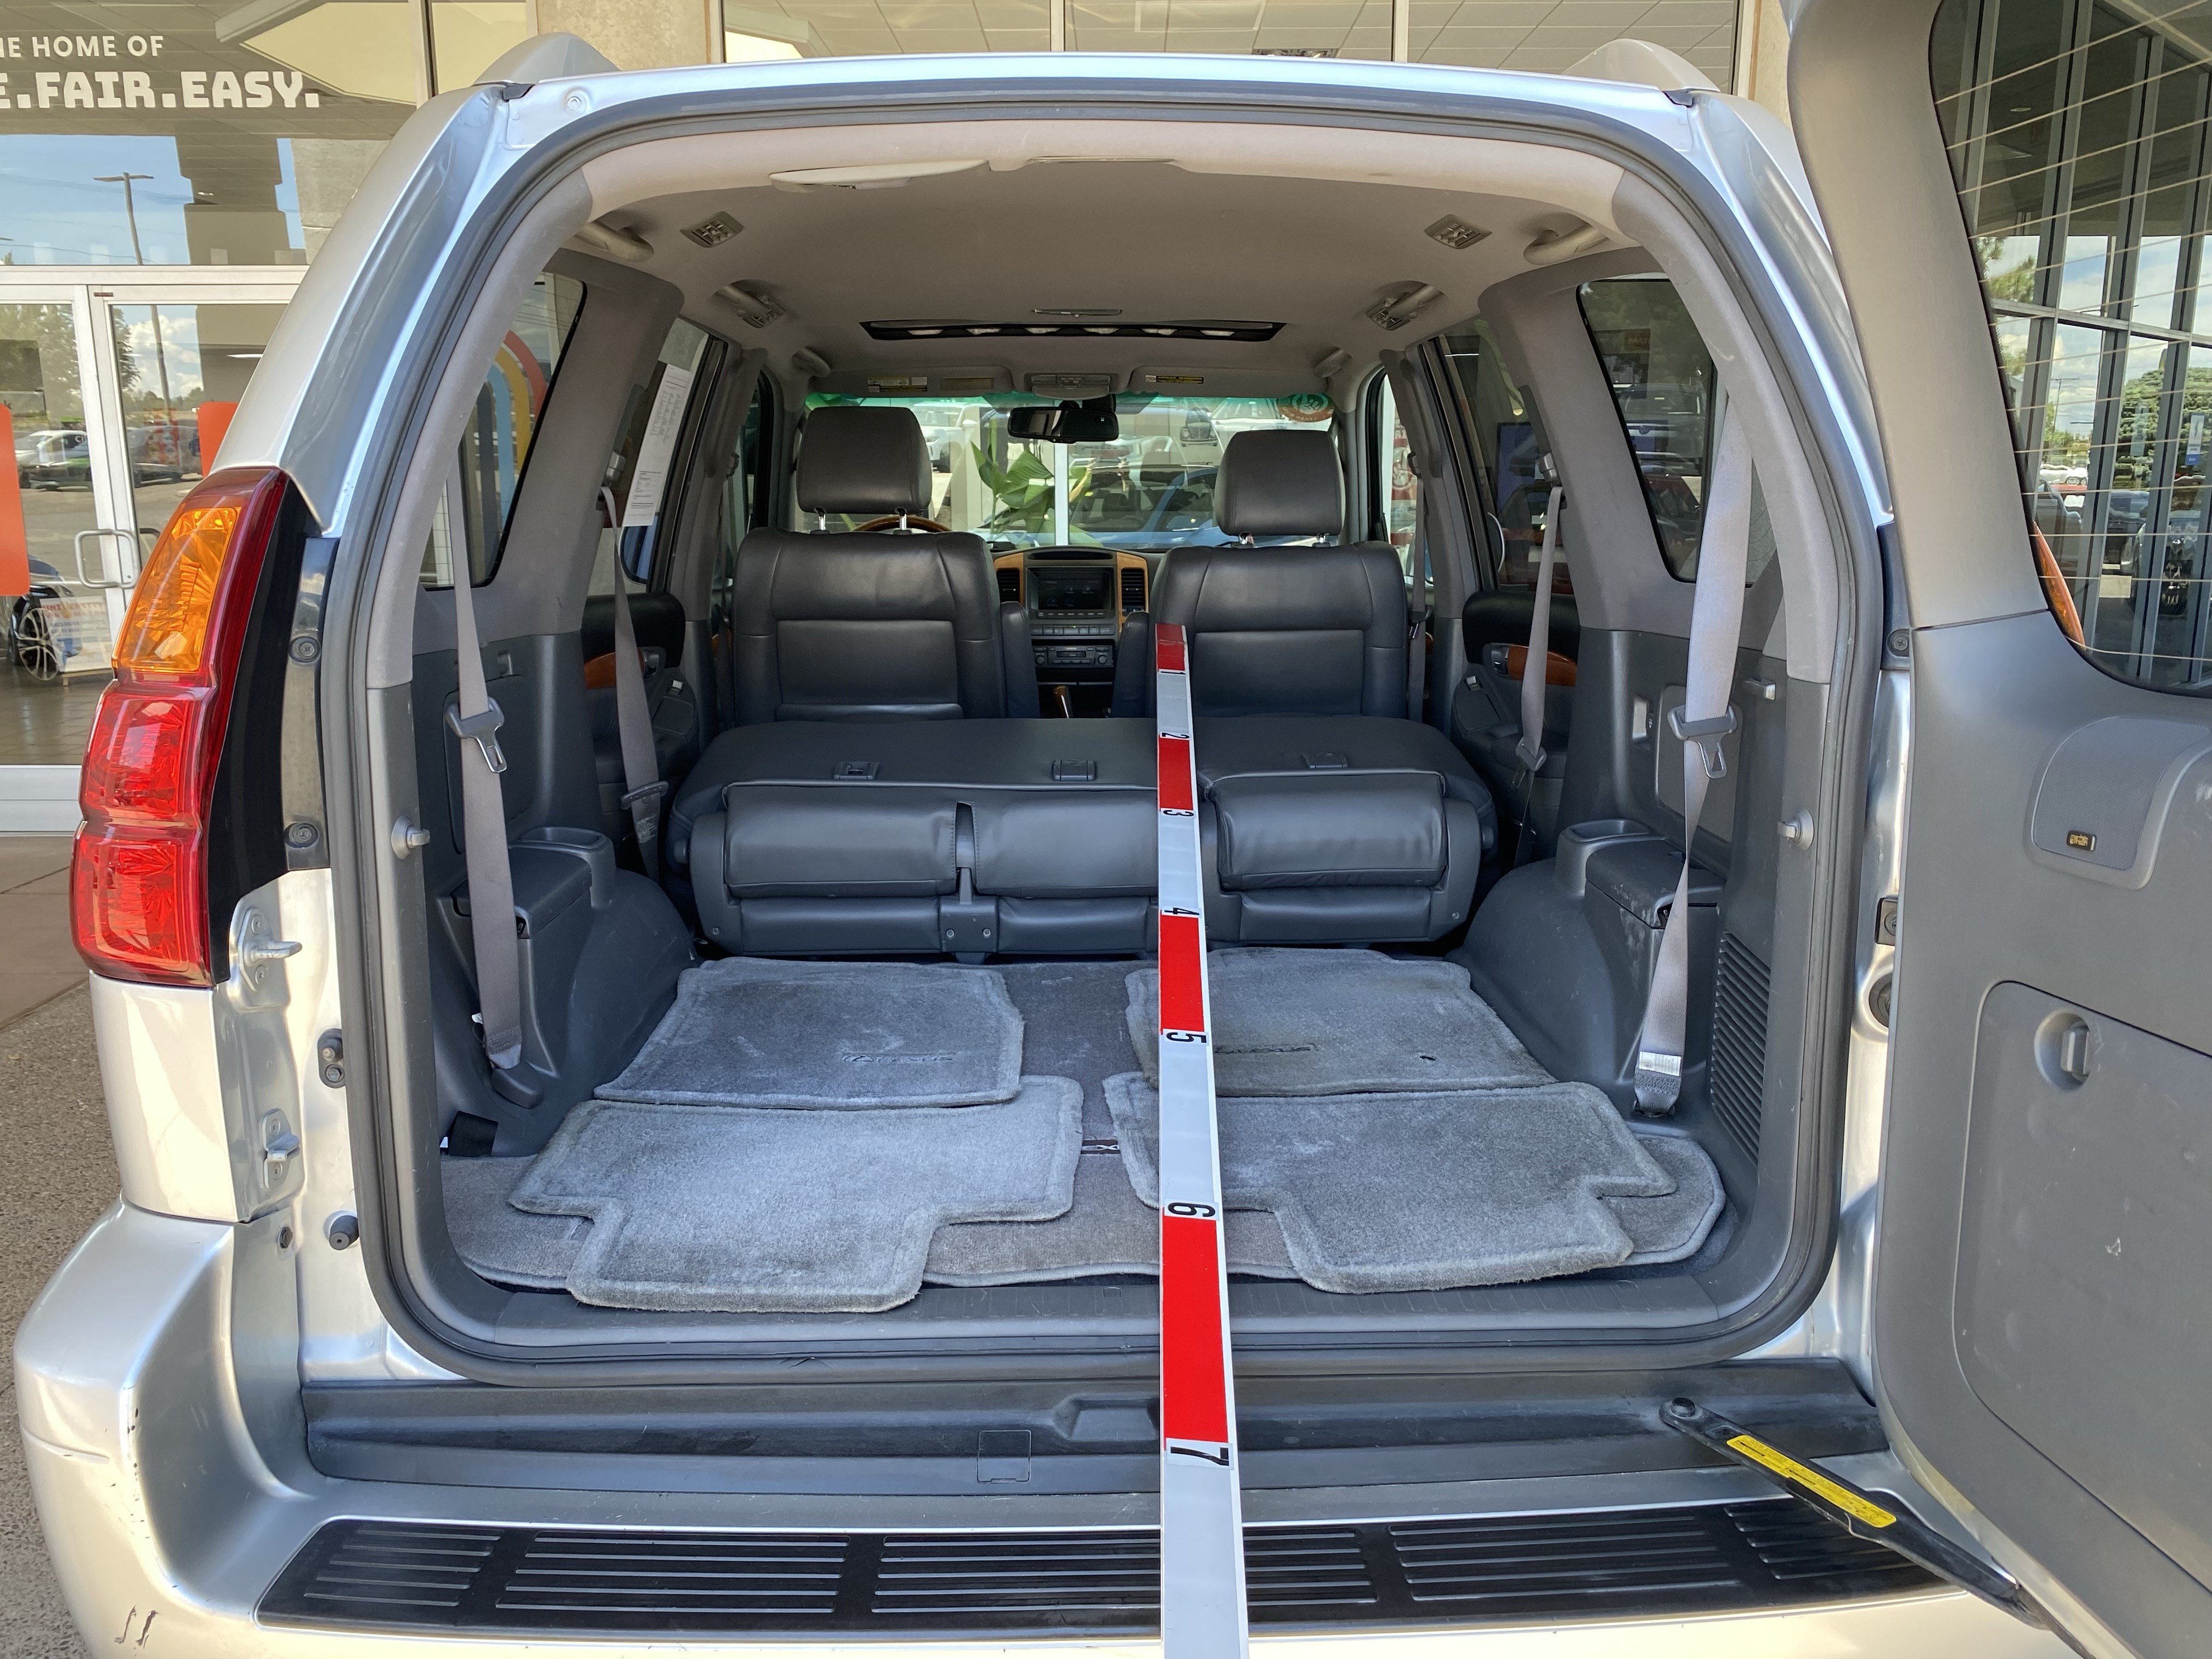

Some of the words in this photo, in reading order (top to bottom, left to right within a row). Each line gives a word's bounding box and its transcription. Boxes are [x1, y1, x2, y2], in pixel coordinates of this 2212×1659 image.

[0, 37, 21, 58] E
[32, 35, 117, 57] HOME
[127, 35, 163, 57] OF
[1164, 907, 1200, 915] 4
[1166, 1030, 1207, 1043] 5
[1167, 1202, 1216, 1217] 6
[1170, 1447, 1229, 1466] 7
